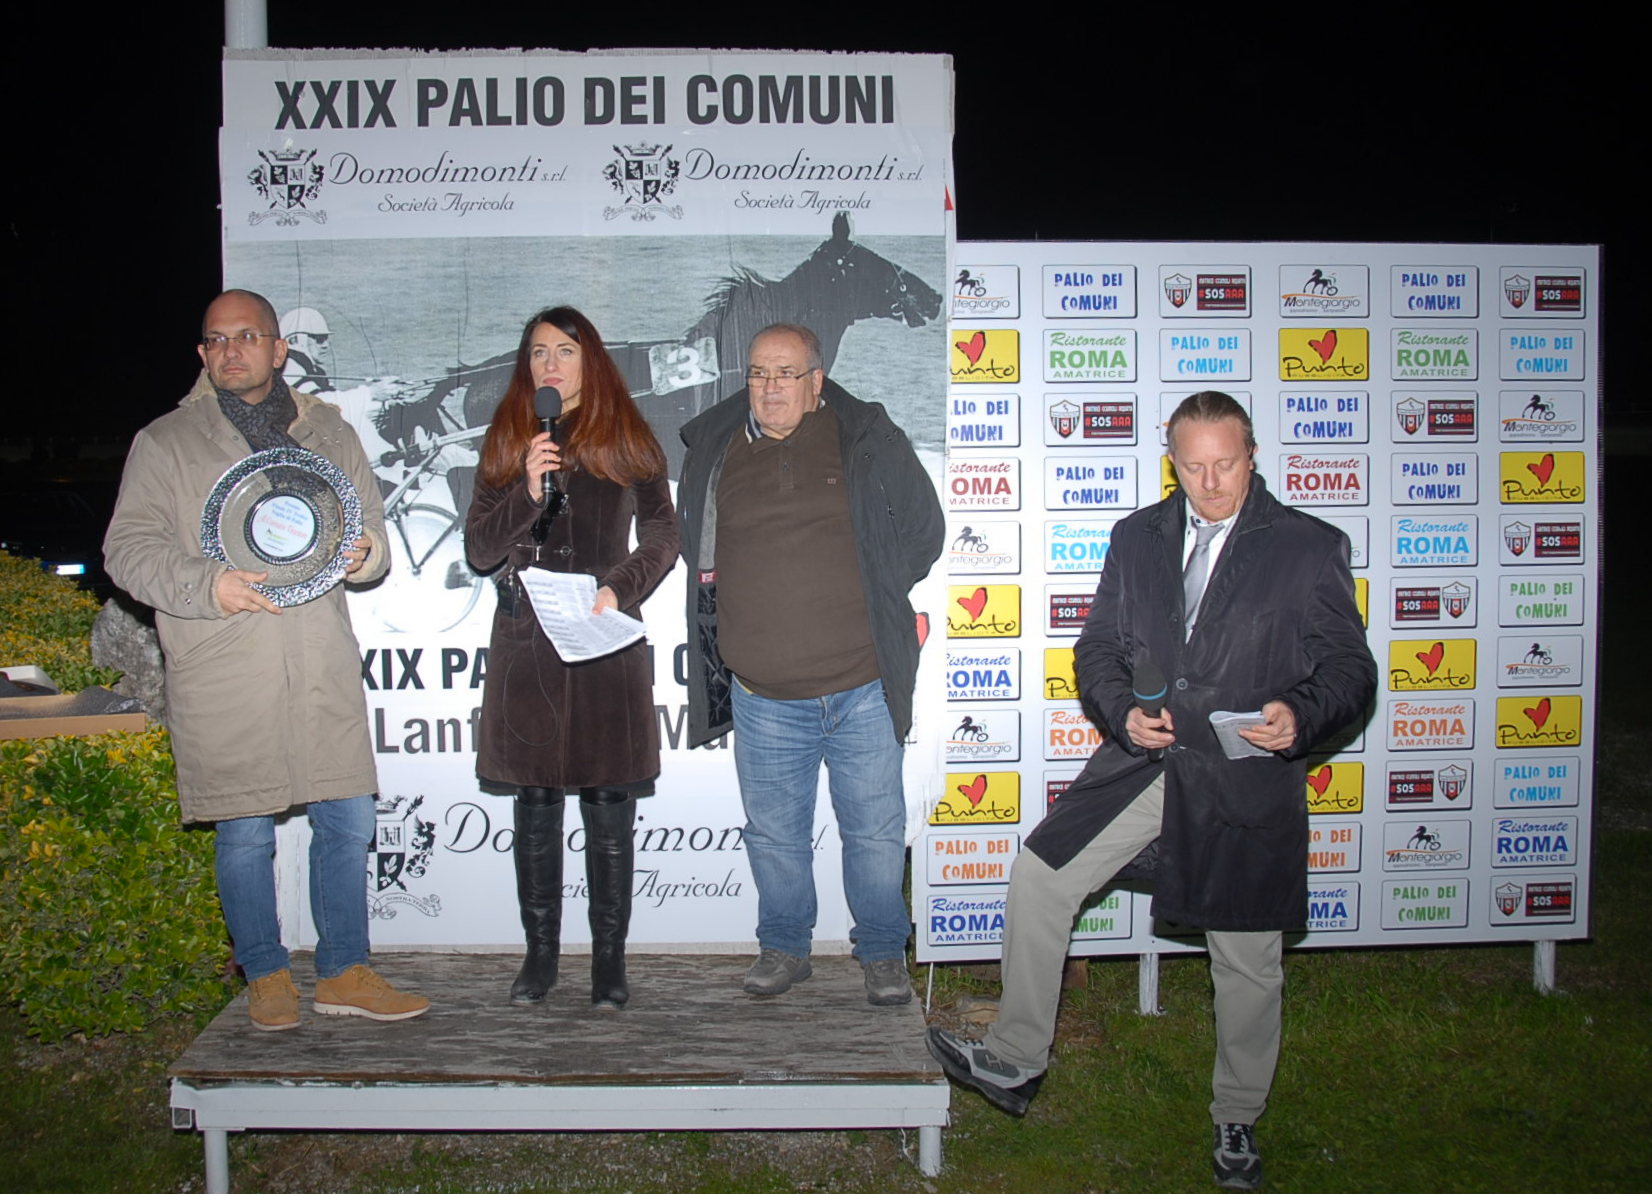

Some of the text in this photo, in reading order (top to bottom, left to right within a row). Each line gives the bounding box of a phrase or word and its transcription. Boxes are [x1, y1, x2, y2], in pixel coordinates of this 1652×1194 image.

[274, 74, 894, 130] XXIX PALIO DEI COMUNI
[329, 150, 542, 185] Domodimonti
[685, 148, 898, 180] Domodimonti
[378, 192, 514, 217] Società Agricola
[734, 190, 871, 215] Società Agricola
[1054, 272, 1123, 287] PALIO DEI
[1402, 273, 1466, 287] PALIO DEI
[1284, 297, 1360, 309] Montegiorgio
[1050, 332, 1127, 347] Ristorante
[1171, 336, 1238, 350] PALIO DEI
[1397, 331, 1469, 345] Ristorante
[1511, 336, 1574, 350] PALIO DEI
[1050, 350, 1128, 368] ROMA
[1397, 349, 1470, 367] ROMA
[667, 347, 701, 387] 3
[950, 359, 1015, 379] unto
[1053, 370, 1126, 378] AMATRICE
[1283, 356, 1364, 378] Punto
[1400, 369, 1468, 377] AMATRICE
[951, 400, 1009, 416] LIO DEI
[1287, 397, 1358, 413] PALIO DEI
[951, 424, 1003, 442] OMUNI
[950, 462, 1012, 473] istorante
[1286, 455, 1360, 470] Ristorante
[1402, 462, 1466, 477] PALIO DEI
[1056, 466, 1124, 481] PALIO DEI
[952, 477, 1012, 495] OMA
[1286, 473, 1361, 491] ROMA
[1503, 480, 1580, 500] Punto
[950, 497, 1009, 505] MATRICE
[1289, 492, 1360, 500] AMATRICE
[1397, 519, 1469, 533] Ristorante
[1051, 542, 1111, 561] ROM
[1397, 536, 1469, 554] ROMA
[1054, 562, 1103, 570] AMATR
[1400, 556, 1468, 564] AMATRICE
[1510, 582, 1573, 596] PALIO DEI
[362, 648, 425, 690] XIX
[1390, 668, 1470, 689] Punto
[948, 689, 1010, 698] MATRICE
[1394, 702, 1466, 717] Ristorante
[375, 706, 481, 754] Lanf
[1393, 718, 1466, 738] ROMA
[1498, 724, 1576, 744] Punto
[1050, 728, 1103, 746] ROM
[1395, 737, 1464, 747] AMATRICE
[1504, 765, 1567, 780] PALIO DEI
[934, 801, 1015, 822] Punto
[1498, 820, 1569, 834] Ristorante
[1330, 829, 1352, 843] DEI
[935, 839, 1009, 855] PALIO DEI
[1497, 836, 1568, 854] ROMA
[1308, 851, 1345, 868] MUNI
[1388, 851, 1463, 864] Montegiorgio
[1500, 854, 1566, 864] AMATRICE
[633, 869, 742, 908] Agricola
[1392, 885, 1456, 900] PALIO DEI
[1310, 902, 1348, 919] MA
[931, 913, 1005, 933] ROMA
[1309, 921, 1347, 929] TRICE
